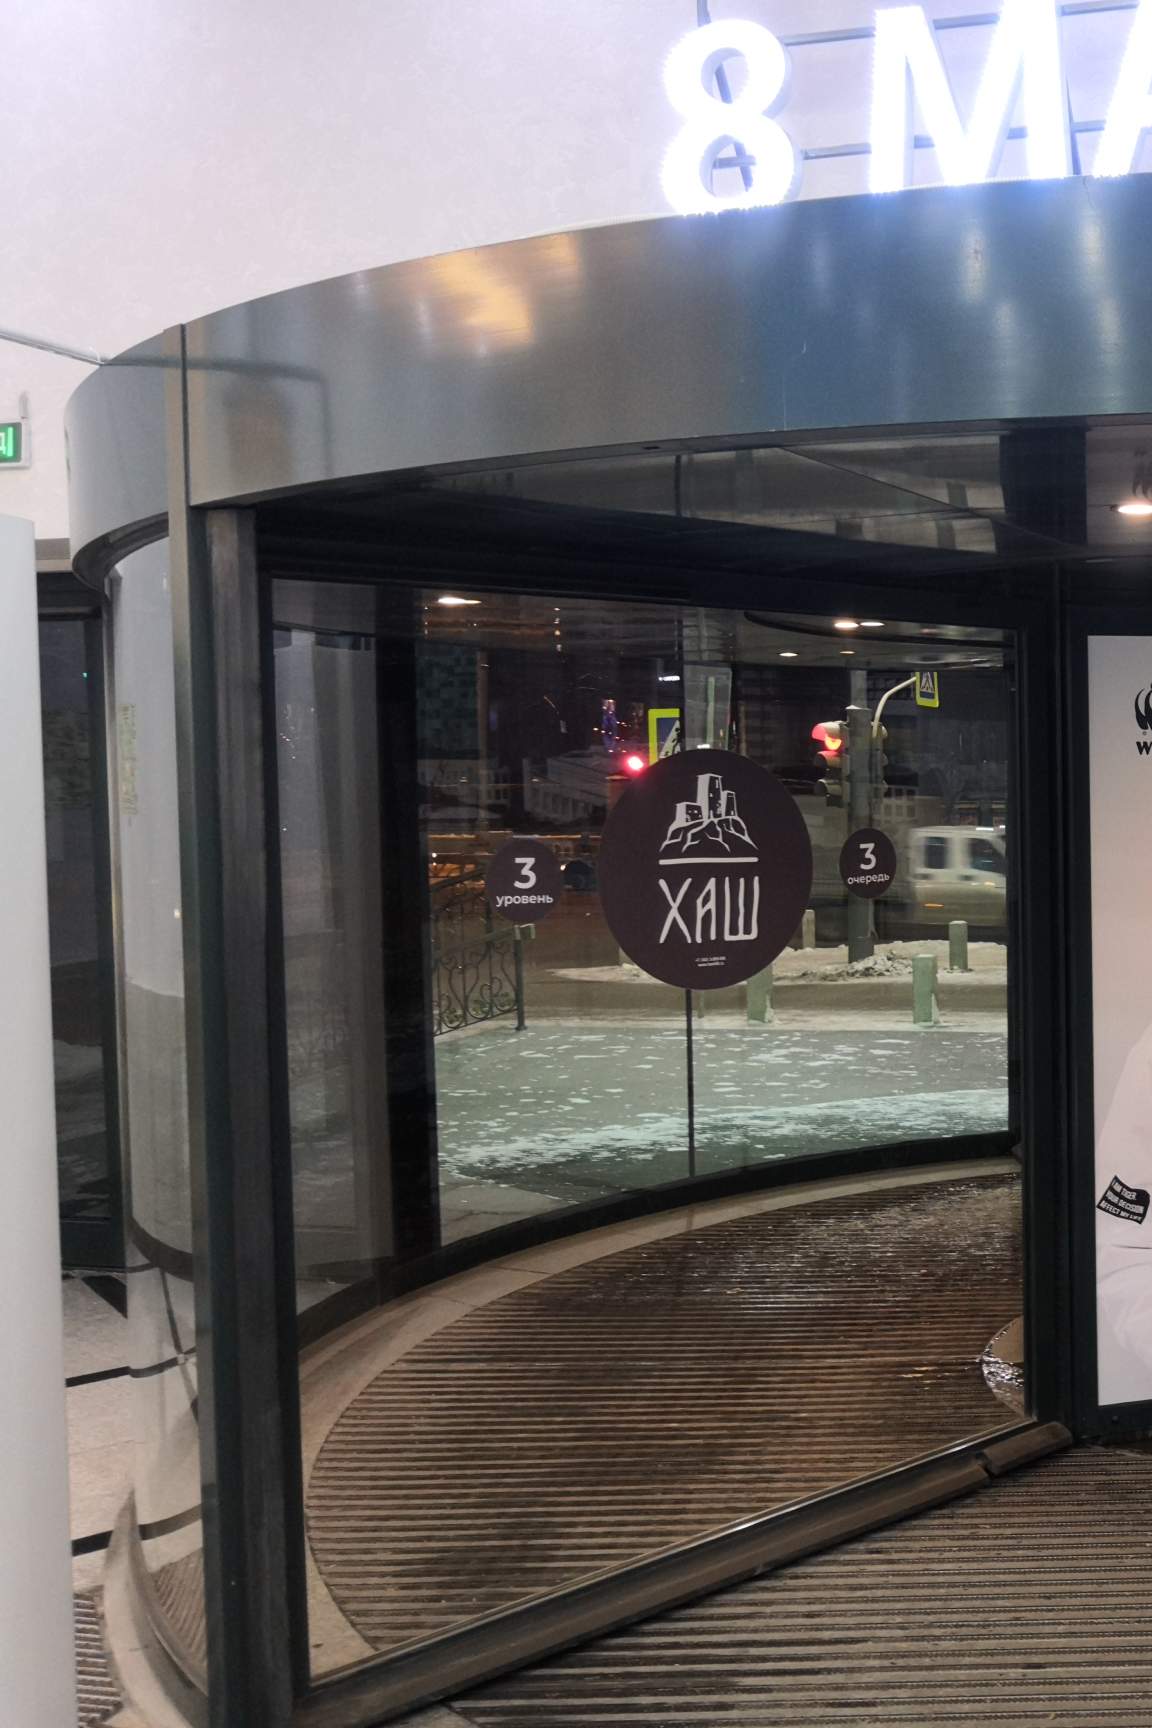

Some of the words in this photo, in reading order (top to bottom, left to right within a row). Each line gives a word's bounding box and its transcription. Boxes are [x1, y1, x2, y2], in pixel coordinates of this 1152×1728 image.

[661, 18, 797, 217] 8
[859, 842, 877, 870] 3
[513, 857, 537, 889] 3
[847, 873, 890, 885] очередь
[495, 894, 554, 908] уровень
[658, 875, 760, 944] ХАШ
